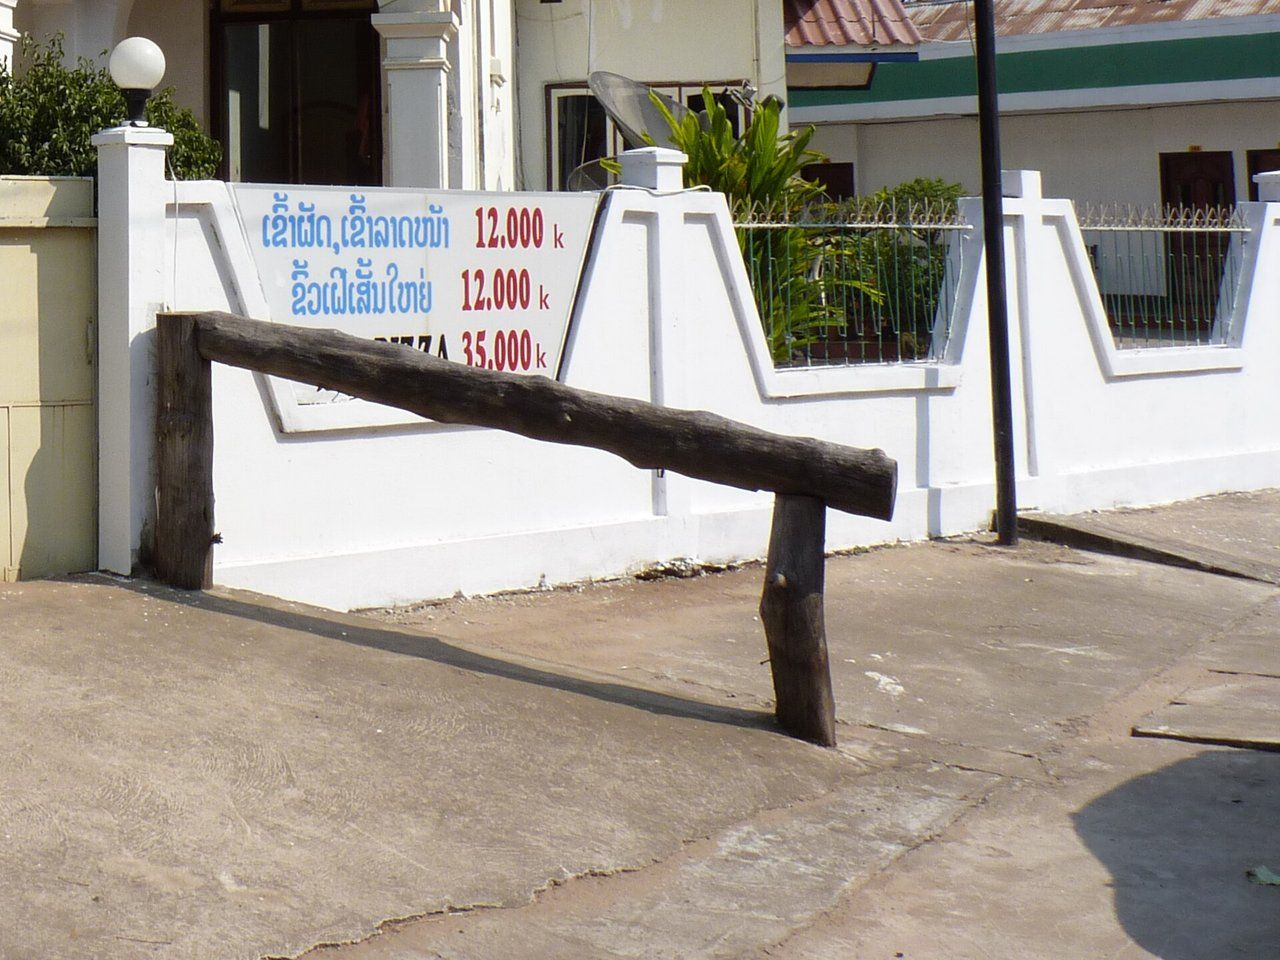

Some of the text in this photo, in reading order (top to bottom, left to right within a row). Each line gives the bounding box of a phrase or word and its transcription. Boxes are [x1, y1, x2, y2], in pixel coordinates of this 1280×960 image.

[475, 206, 544, 249] 12.000
[553, 223, 565, 249] k
[461, 268, 531, 312] 12.000
[539, 284, 551, 311] k
[462, 329, 532, 372] 35.000
[536, 343, 548, 370] k
